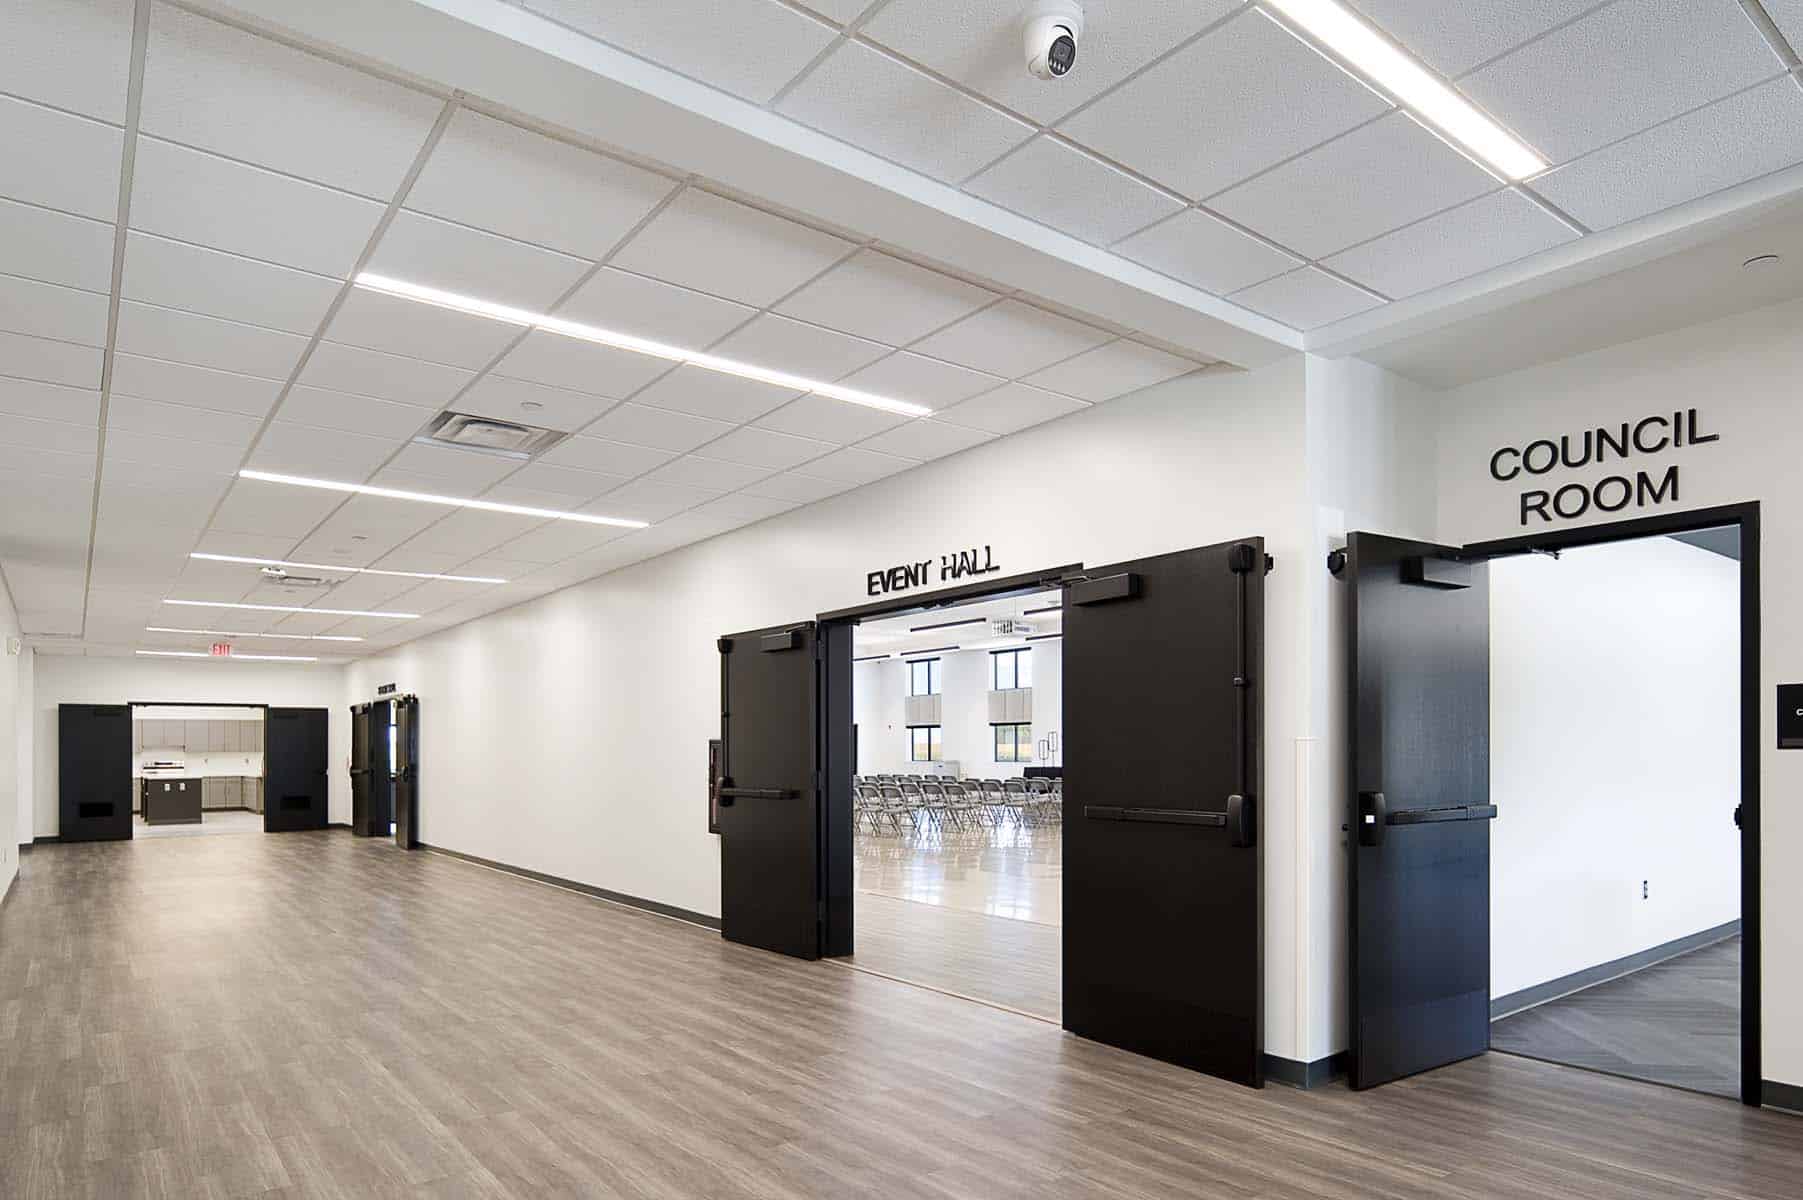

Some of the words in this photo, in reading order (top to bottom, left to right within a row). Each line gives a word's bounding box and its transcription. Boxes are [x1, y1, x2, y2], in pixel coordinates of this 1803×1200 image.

[1489, 408, 1720, 481] COUNCIL
[1520, 465, 1679, 526] ROOM
[867, 559, 932, 596] EVENT
[941, 545, 1000, 581] HALL
